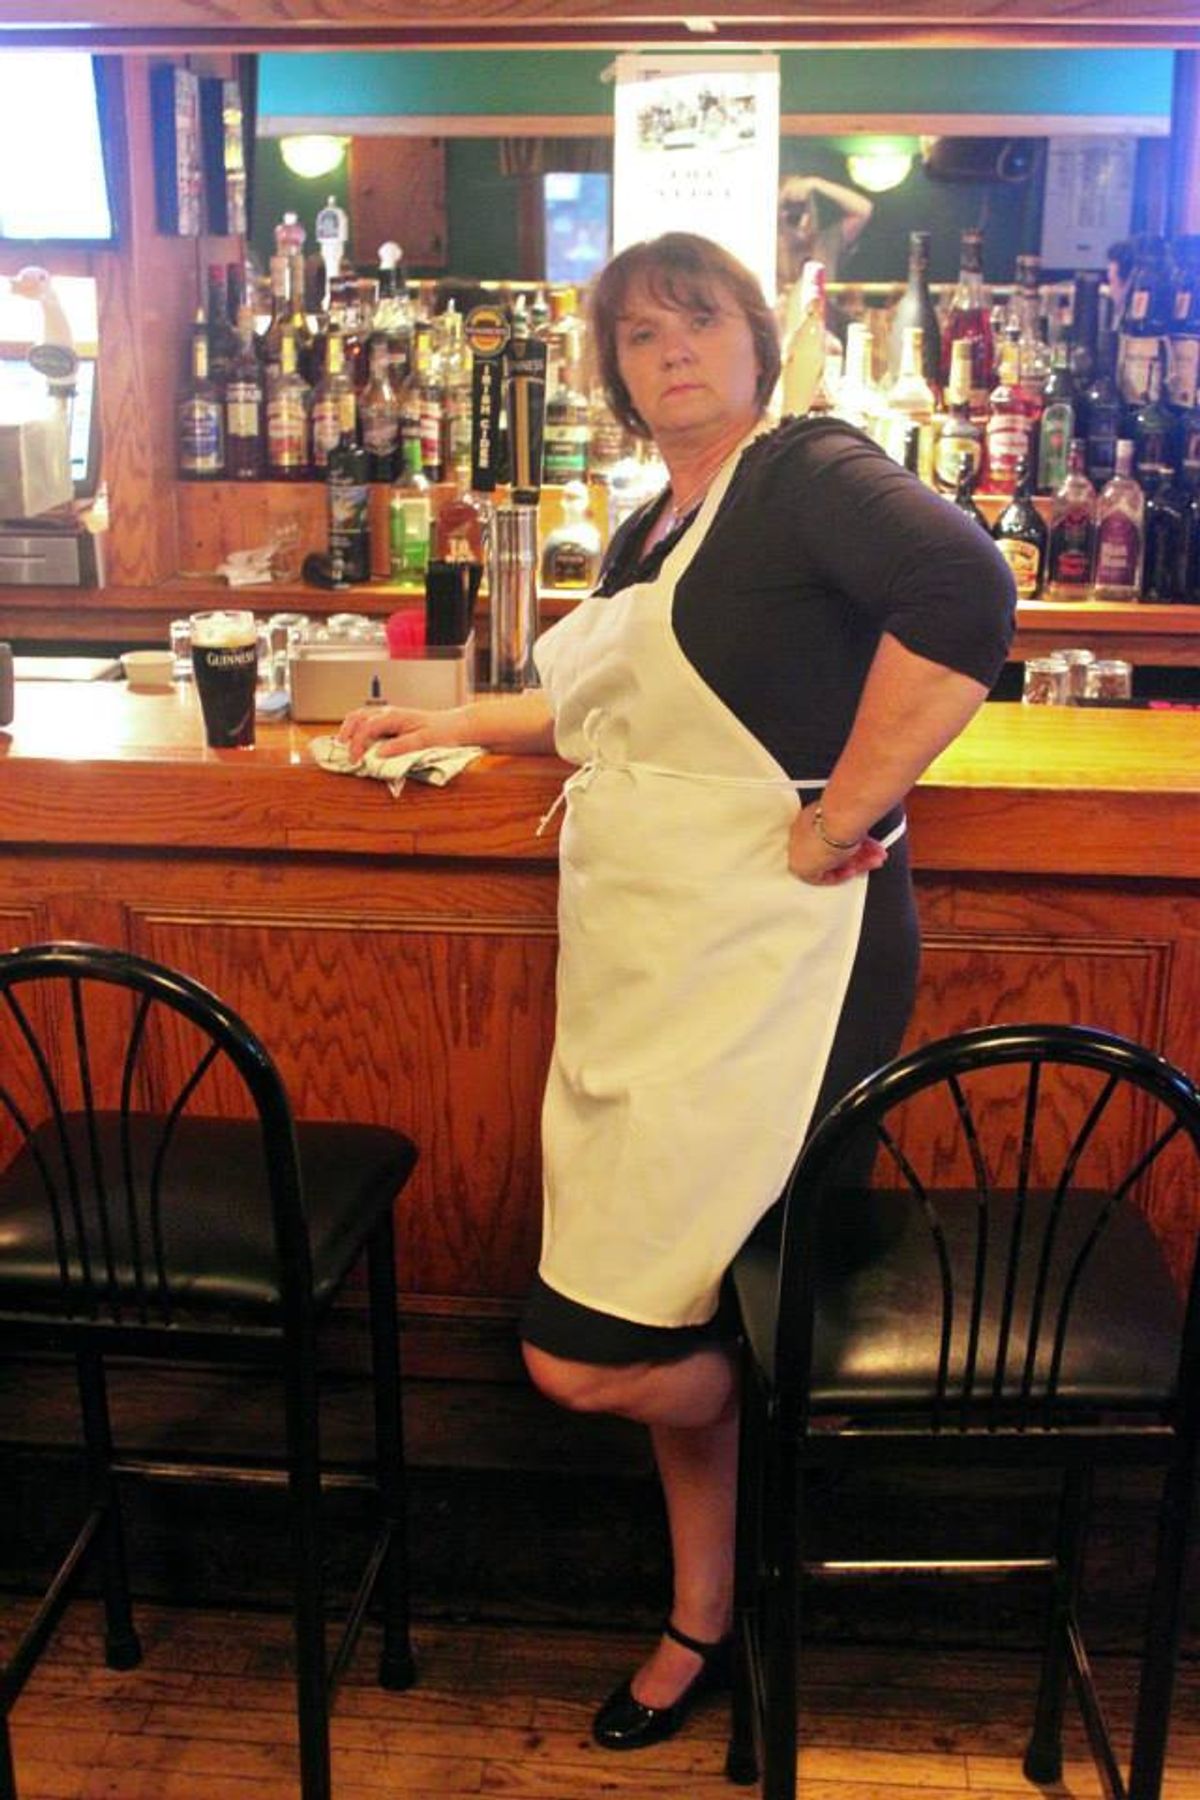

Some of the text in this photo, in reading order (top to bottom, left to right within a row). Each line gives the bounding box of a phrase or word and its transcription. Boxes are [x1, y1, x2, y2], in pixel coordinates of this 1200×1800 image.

[479, 364, 492, 469] IRISH CIDER
[206, 650, 255, 667] GUINNESS
